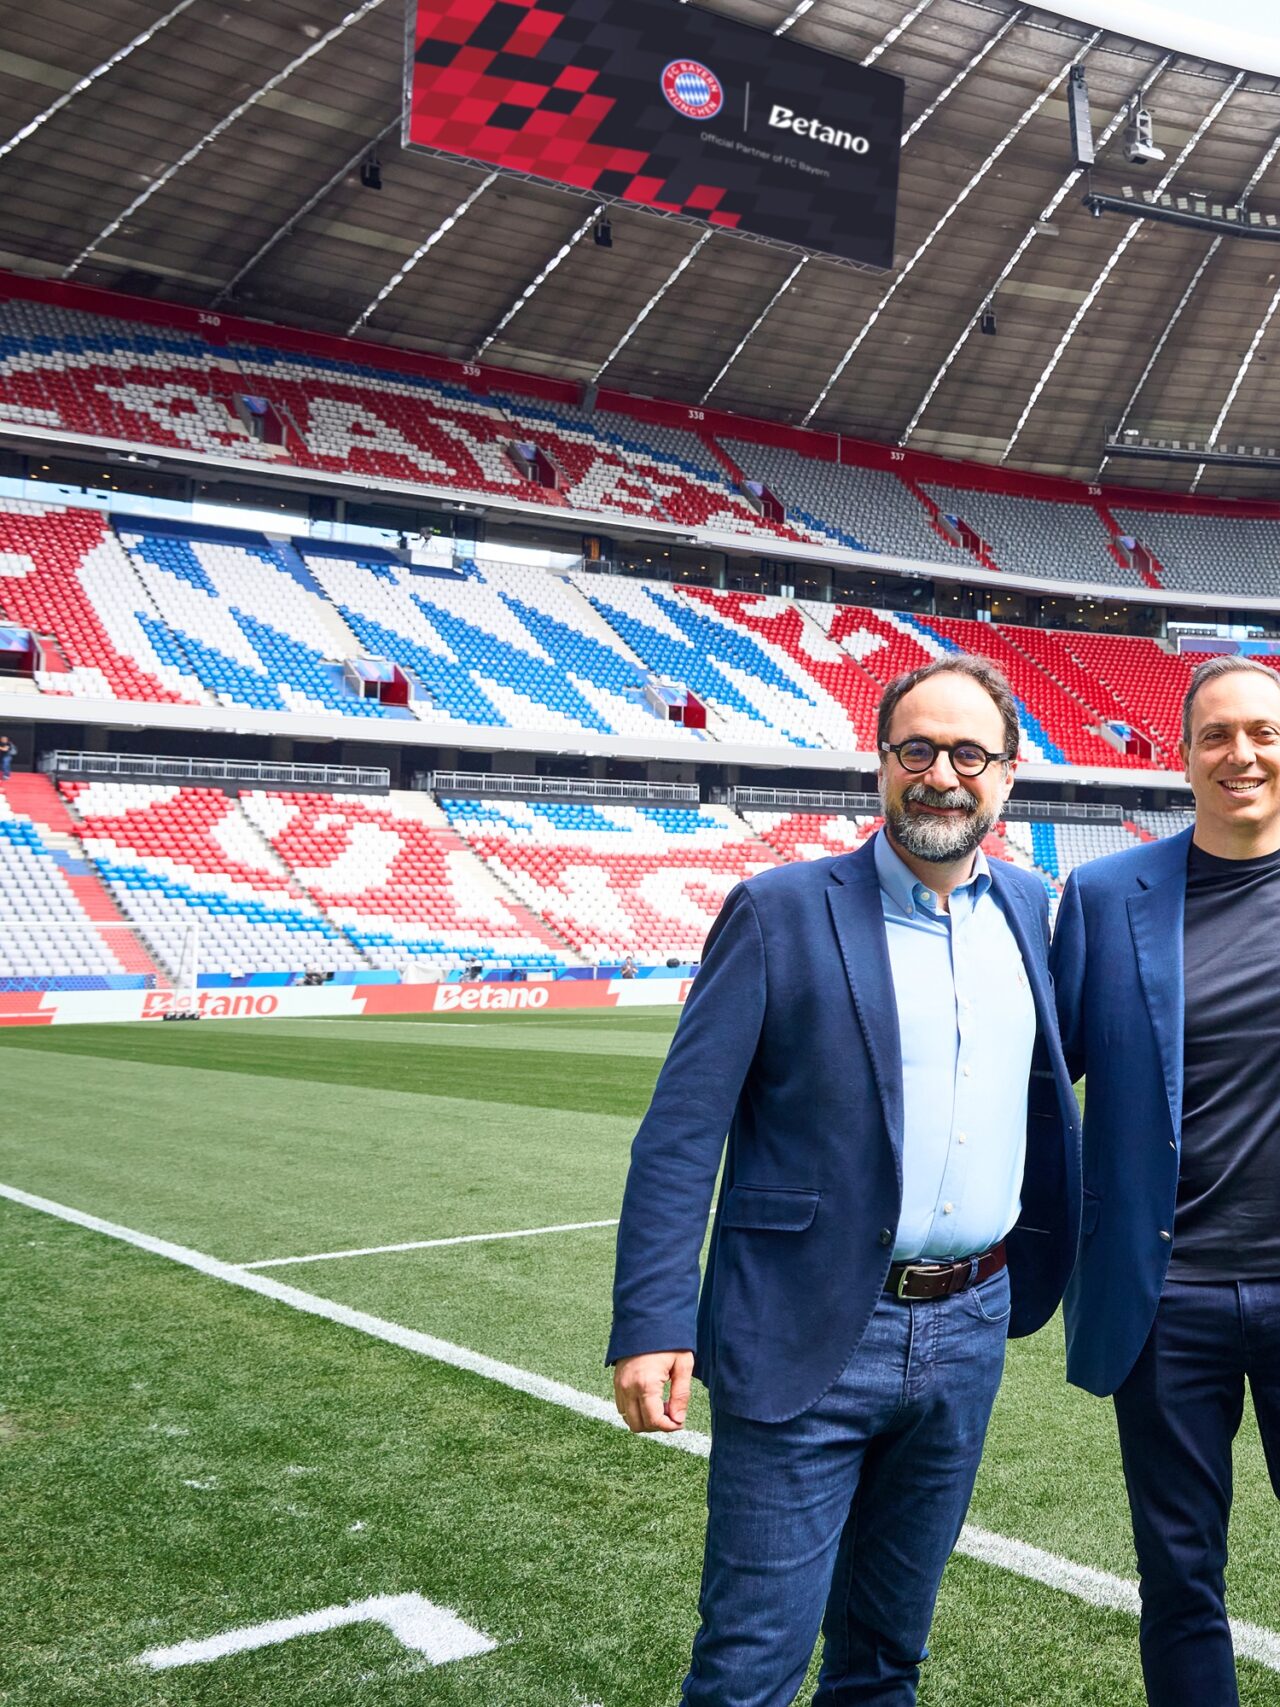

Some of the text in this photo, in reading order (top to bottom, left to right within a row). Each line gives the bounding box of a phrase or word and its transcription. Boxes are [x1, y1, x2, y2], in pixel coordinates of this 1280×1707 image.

[667, 63, 719, 92] FC BAYERN
[768, 104, 870, 154] Betano
[700, 131, 830, 178] Official Partner of FC Bayern
[198, 313, 221, 327] 340
[462, 365, 481, 377] 339
[688, 410, 705, 420] 338
[891, 451, 905, 461] 337
[433, 984, 549, 1011] Betano
